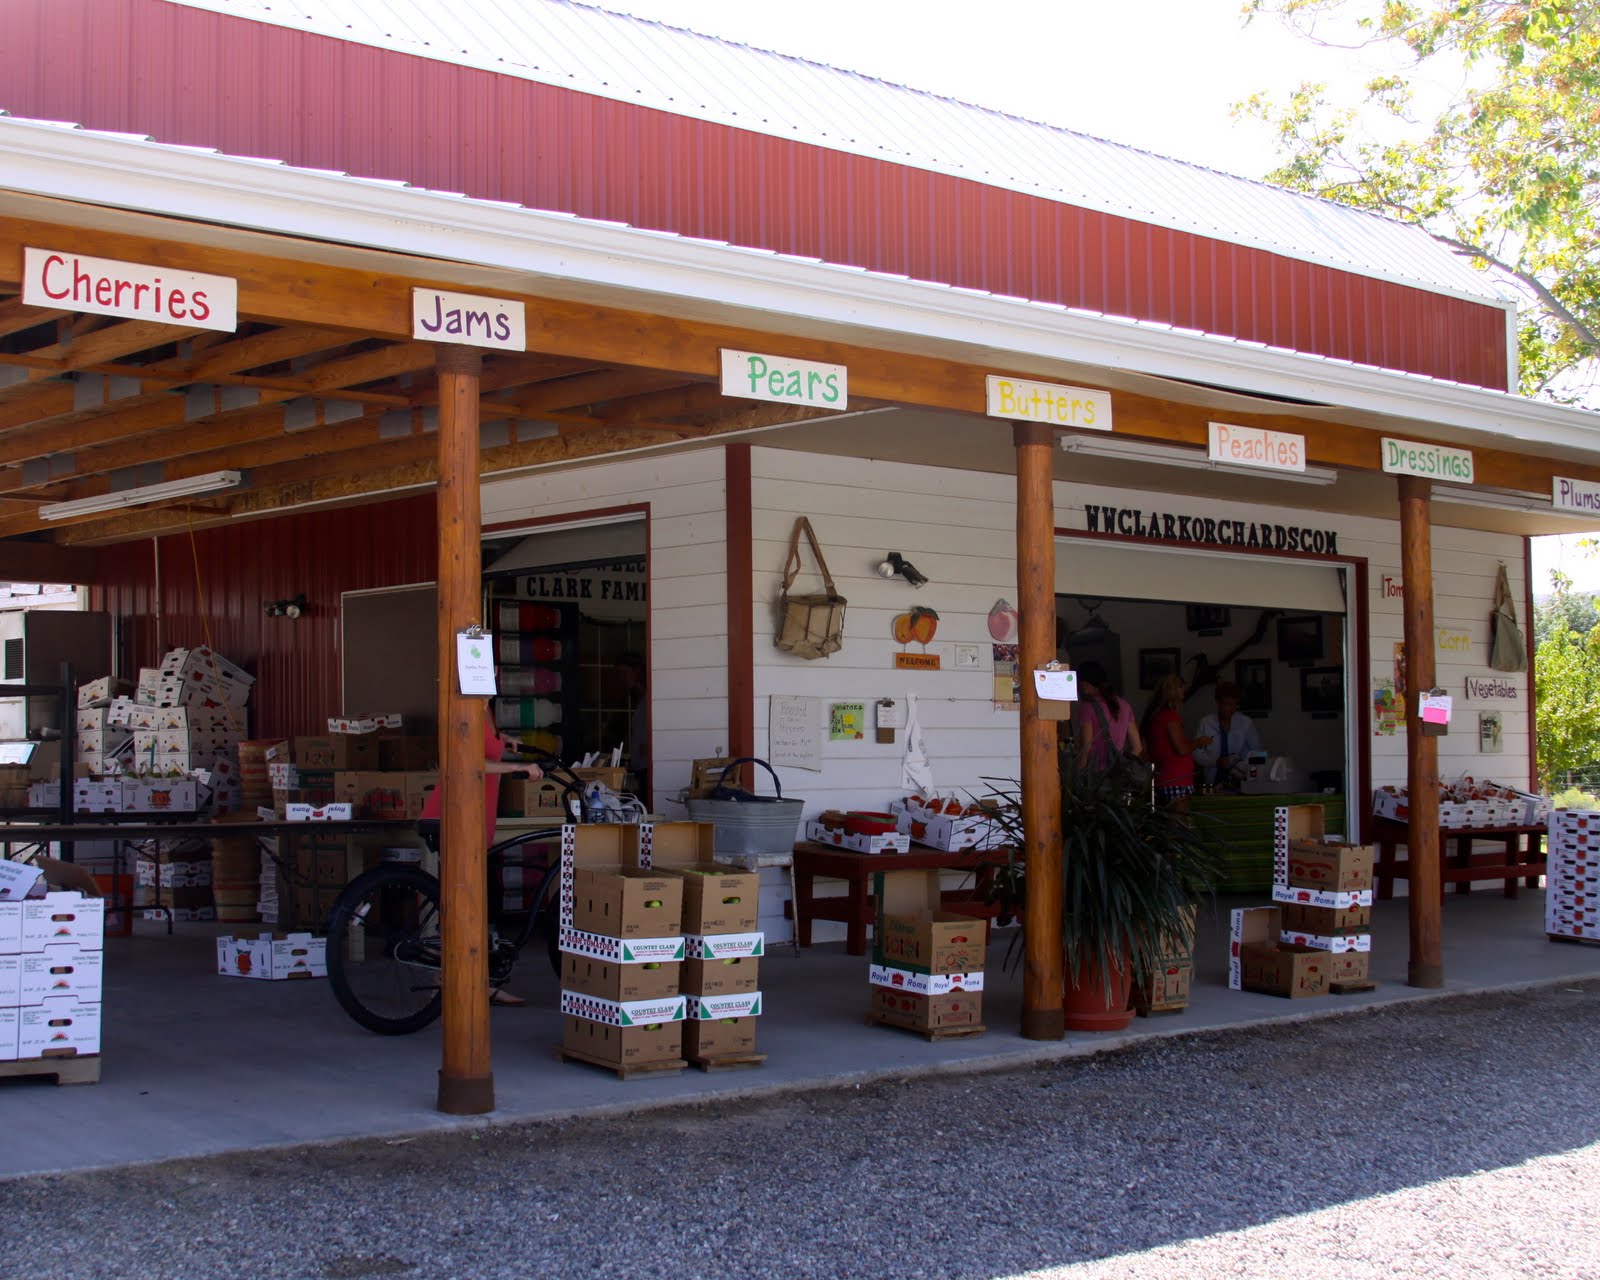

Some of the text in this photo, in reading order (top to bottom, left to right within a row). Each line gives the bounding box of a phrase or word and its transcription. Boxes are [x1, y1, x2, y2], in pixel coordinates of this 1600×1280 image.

[41, 255, 211, 321] Cherries
[420, 294, 511, 341] Jams
[747, 355, 839, 402] Pears
[998, 380, 1096, 424] Butters
[1217, 426, 1299, 466] Peaches
[1560, 479, 1600, 510] Plums
[527, 577, 592, 598] CLARK
[1439, 630, 1470, 651] Corn
[899, 656, 936, 667] WELCOME
[1470, 679, 1517, 699] Vegetables
[1274, 890, 1335, 905] Royal Roma
[564, 935, 614, 952] FRESH TOMATOES
[713, 942, 737, 950] COUNTRY
[1308, 939, 1329, 949] Roma
[871, 971, 927, 990] Royal Roma
[933, 979, 980, 989] Royal Roma
[567, 1001, 616, 1019] FRESH TOMATOES
[631, 1008, 656, 1016] COUNTRY
[710, 1001, 734, 1010] COUNTRY
